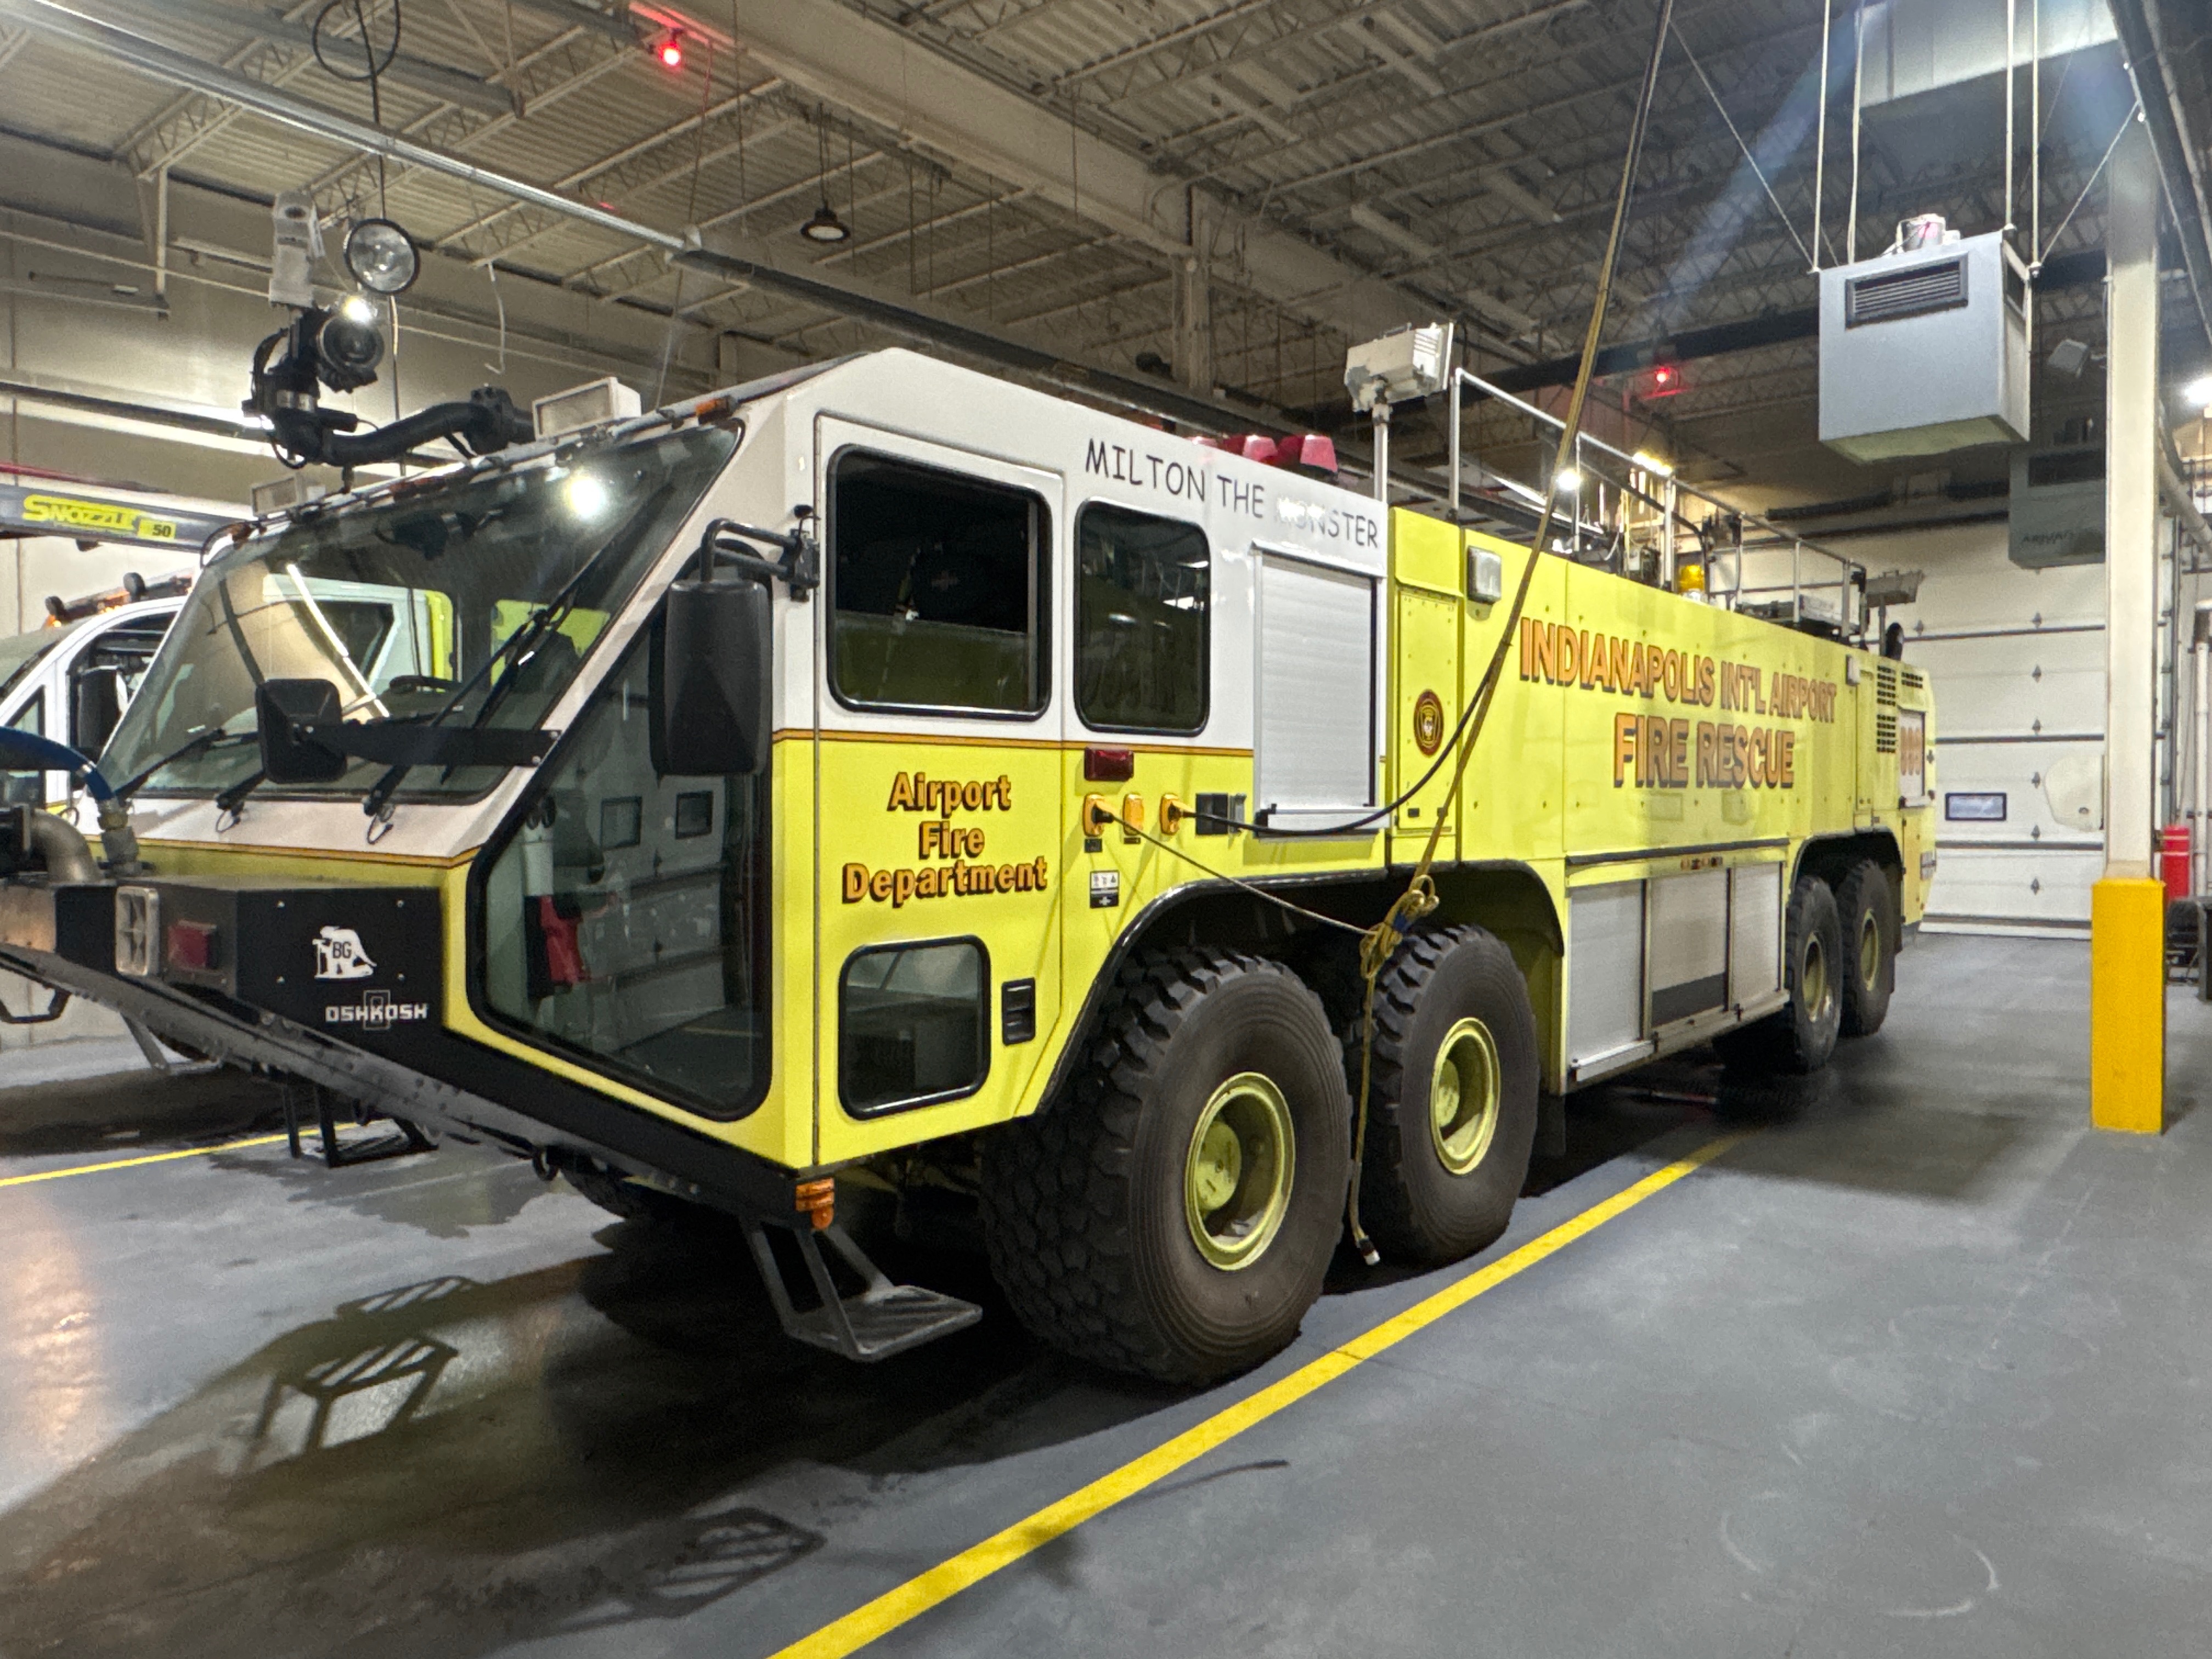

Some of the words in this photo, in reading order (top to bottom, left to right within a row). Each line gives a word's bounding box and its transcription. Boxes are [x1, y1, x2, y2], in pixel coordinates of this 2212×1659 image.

[1086, 438, 1205, 502] MILTON
[1217, 474, 1264, 518] THE
[1275, 495, 1378, 549] ONSTER
[152, 524, 172, 538] 50
[1520, 617, 1715, 707] INDIANAPOLIS
[1769, 672, 1837, 723] AIRPORT
[1614, 713, 1689, 788] FIRE
[1696, 720, 1795, 788] RESCUE
[887, 772, 1011, 816] Airport
[919, 821, 985, 859] Fire
[842, 856, 1048, 909] Department
[332, 941, 352, 959] BG
[325, 1003, 428, 1023] OSHKOSH
